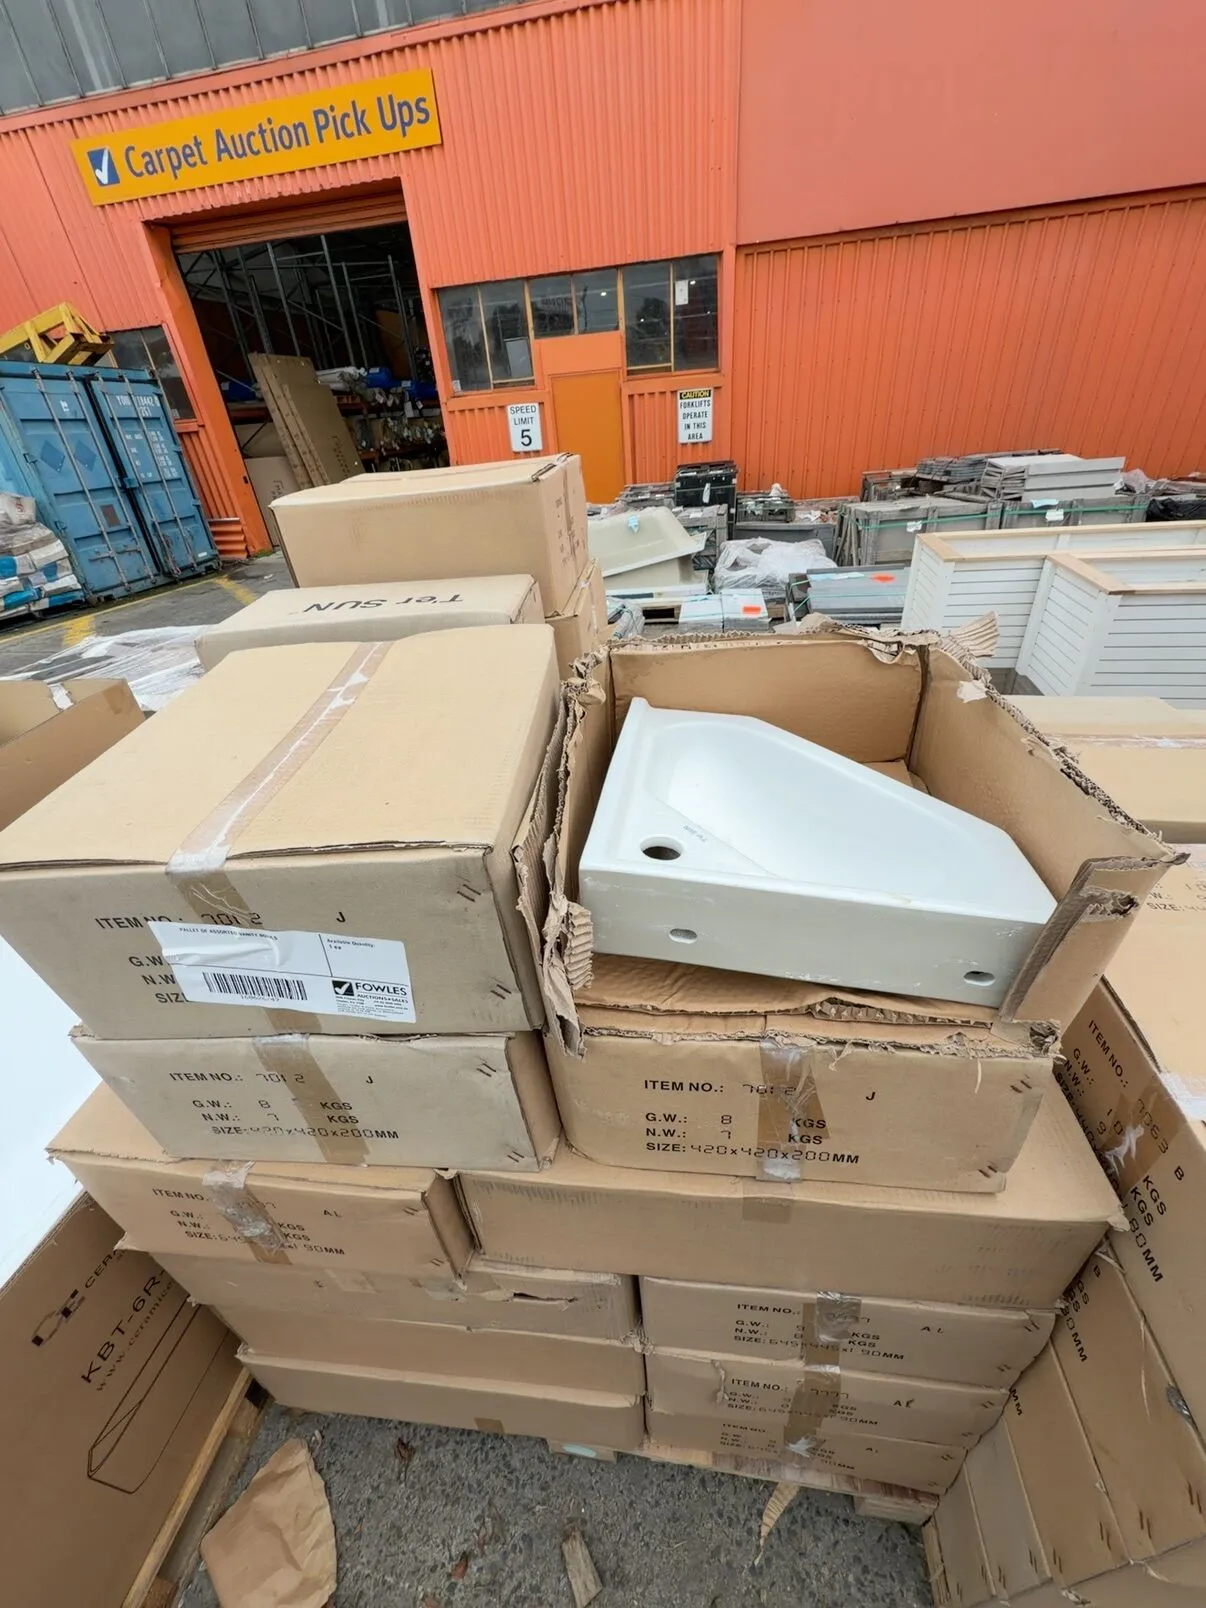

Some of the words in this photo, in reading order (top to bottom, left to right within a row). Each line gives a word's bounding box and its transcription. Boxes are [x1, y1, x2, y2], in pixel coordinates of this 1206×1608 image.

[124, 135, 208, 179] Carpet
[214, 118, 310, 162] Auction
[312, 100, 372, 144] Pick
[376, 94, 430, 138] Ups
[681, 389, 710, 399] CAUTION
[509, 404, 537, 415] SPEED
[680, 399, 711, 409] FORKLIFTS
[513, 416, 535, 426] LIMIT
[682, 410, 708, 420] OPERATE
[693, 421, 706, 430] THIS
[520, 428, 533, 447] 5
[687, 432, 703, 440] AREA
[303, 599, 388, 613] SUN
[95, 916, 145, 930] ITEM
[335, 911, 347, 923] J
[354, 982, 408, 996] FOWLES
[168, 1071, 209, 1082] ITEM
[208, 1071, 244, 1082] NO.:
[365, 1075, 374, 1084] J
[644, 1079, 684, 1091] ITEM
[688, 1081, 724, 1093] NO.:
[865, 1091, 876, 1101] J
[192, 1099, 232, 1109] G.W.:
[258, 1099, 271, 1109] 8
[319, 1101, 353, 1111] KGS
[1088, 1019, 1111, 1056] ITEM
[1108, 1055, 1129, 1088] NO.:
[1173, 1165, 1185, 1181] B
[201, 1112, 240, 1122] N.W.:
[326, 1114, 360, 1125] KGS
[645, 1112, 688, 1123] G.W.:
[720, 1114, 732, 1125] 8
[792, 1117, 827, 1130] KGS
[645, 1127, 687, 1138] N.W.:
[720, 1129, 732, 1140] 7
[787, 1133, 823, 1146] KGS
[1073, 1047, 1095, 1086] G.W.:
[1142, 1174, 1167, 1216] KGS
[1063, 1060, 1085, 1097] N.W.:
[1130, 1185, 1154, 1226] KGS
[152, 1187, 185, 1198] ITEM
[278, 1222, 306, 1232] KGS
[282, 1232, 311, 1242] KGS
[1076, 1278, 1090, 1305] GS
[737, 1303, 769, 1312] ITEM
[851, 1331, 880, 1341] KGS
[847, 1339, 877, 1349] KGS
[731, 1378, 761, 1389] ITEM
[762, 1382, 789, 1392] NO.:
